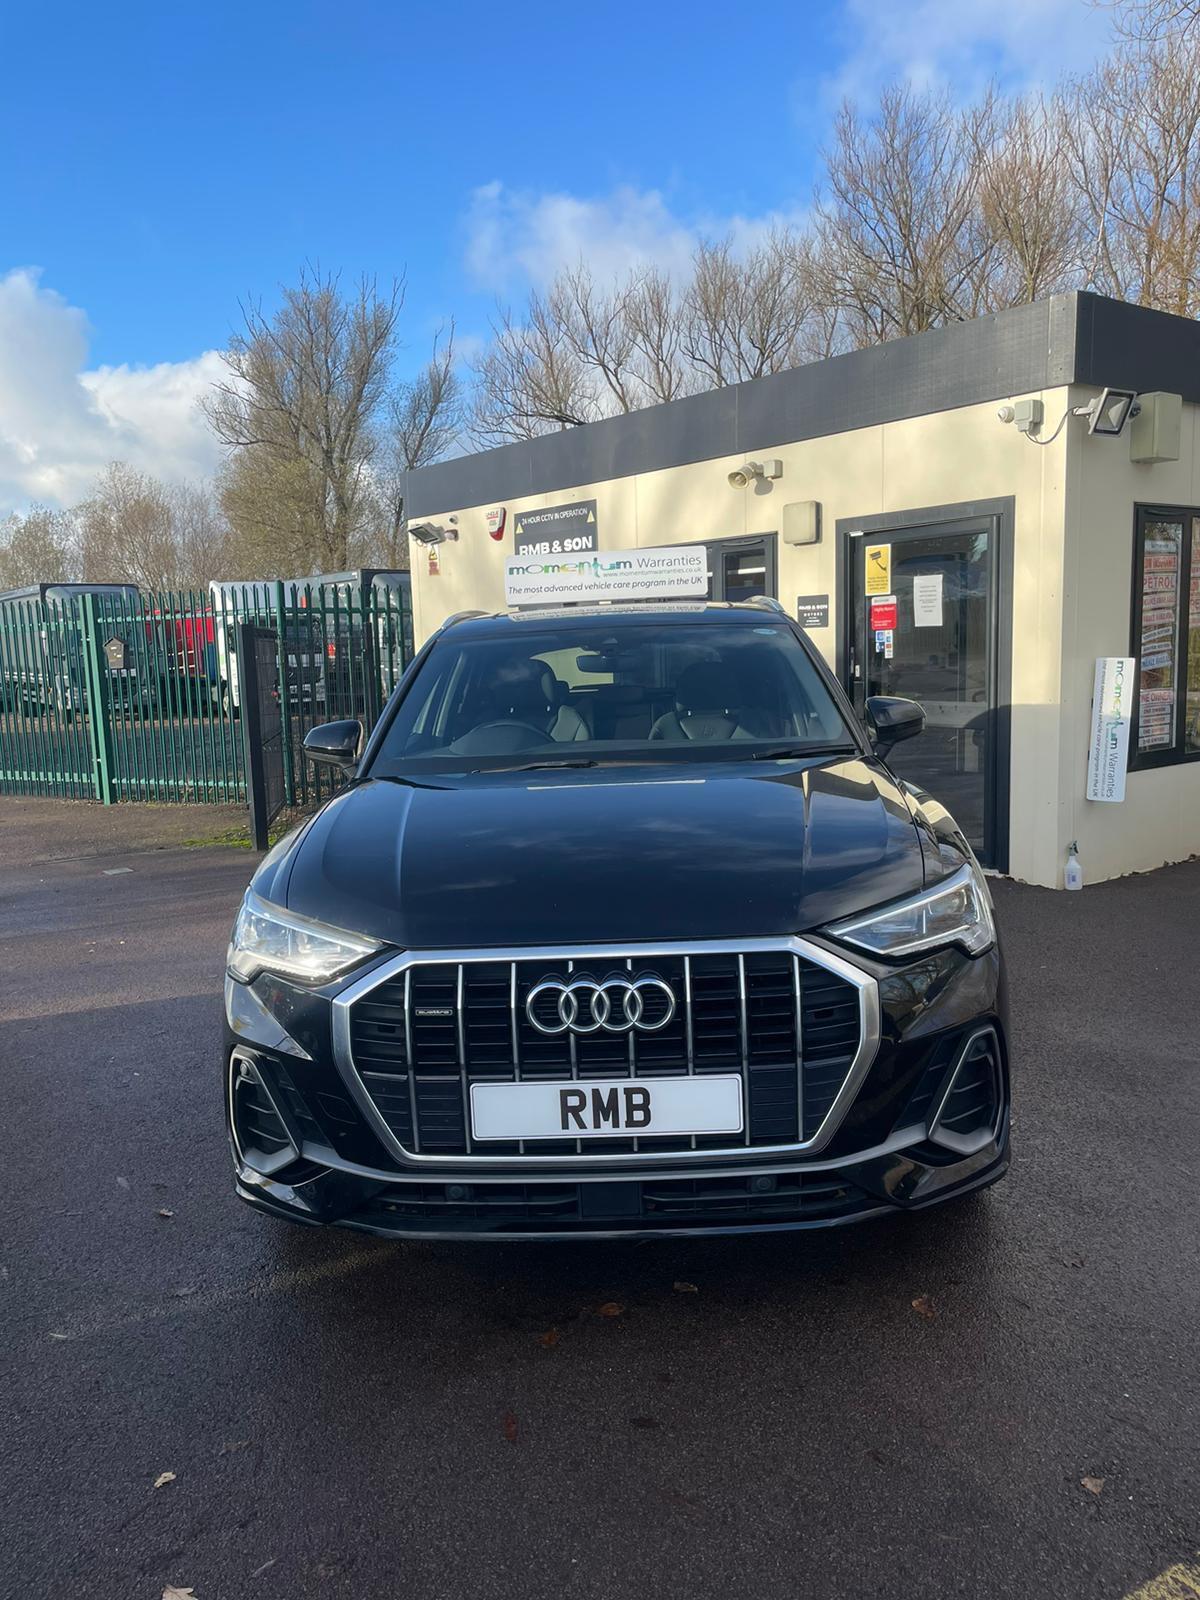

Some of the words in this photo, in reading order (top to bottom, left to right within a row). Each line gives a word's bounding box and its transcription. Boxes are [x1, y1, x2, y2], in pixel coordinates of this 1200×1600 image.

[528, 516, 541, 524] HOUR
[541, 514, 554, 522] CCTV
[560, 507, 588, 519] OPERATION
[519, 542, 550, 556] RMB
[551, 540, 562, 553] &
[564, 536, 592, 551] SON
[508, 557, 632, 578] momentum
[637, 555, 701, 568] Warranties
[508, 586, 522, 594] The
[523, 585, 543, 593] most
[544, 583, 583, 592] advanced
[584, 582, 611, 590] vehicle
[632, 580, 666, 589] program
[691, 576, 703, 584] UK
[1143, 576, 1174, 589] PETROL
[1106, 660, 1124, 749] momentum
[1106, 752, 1118, 798] Warranties
[1093, 788, 1098, 797] UK
[560, 1086, 651, 1130] RMB
